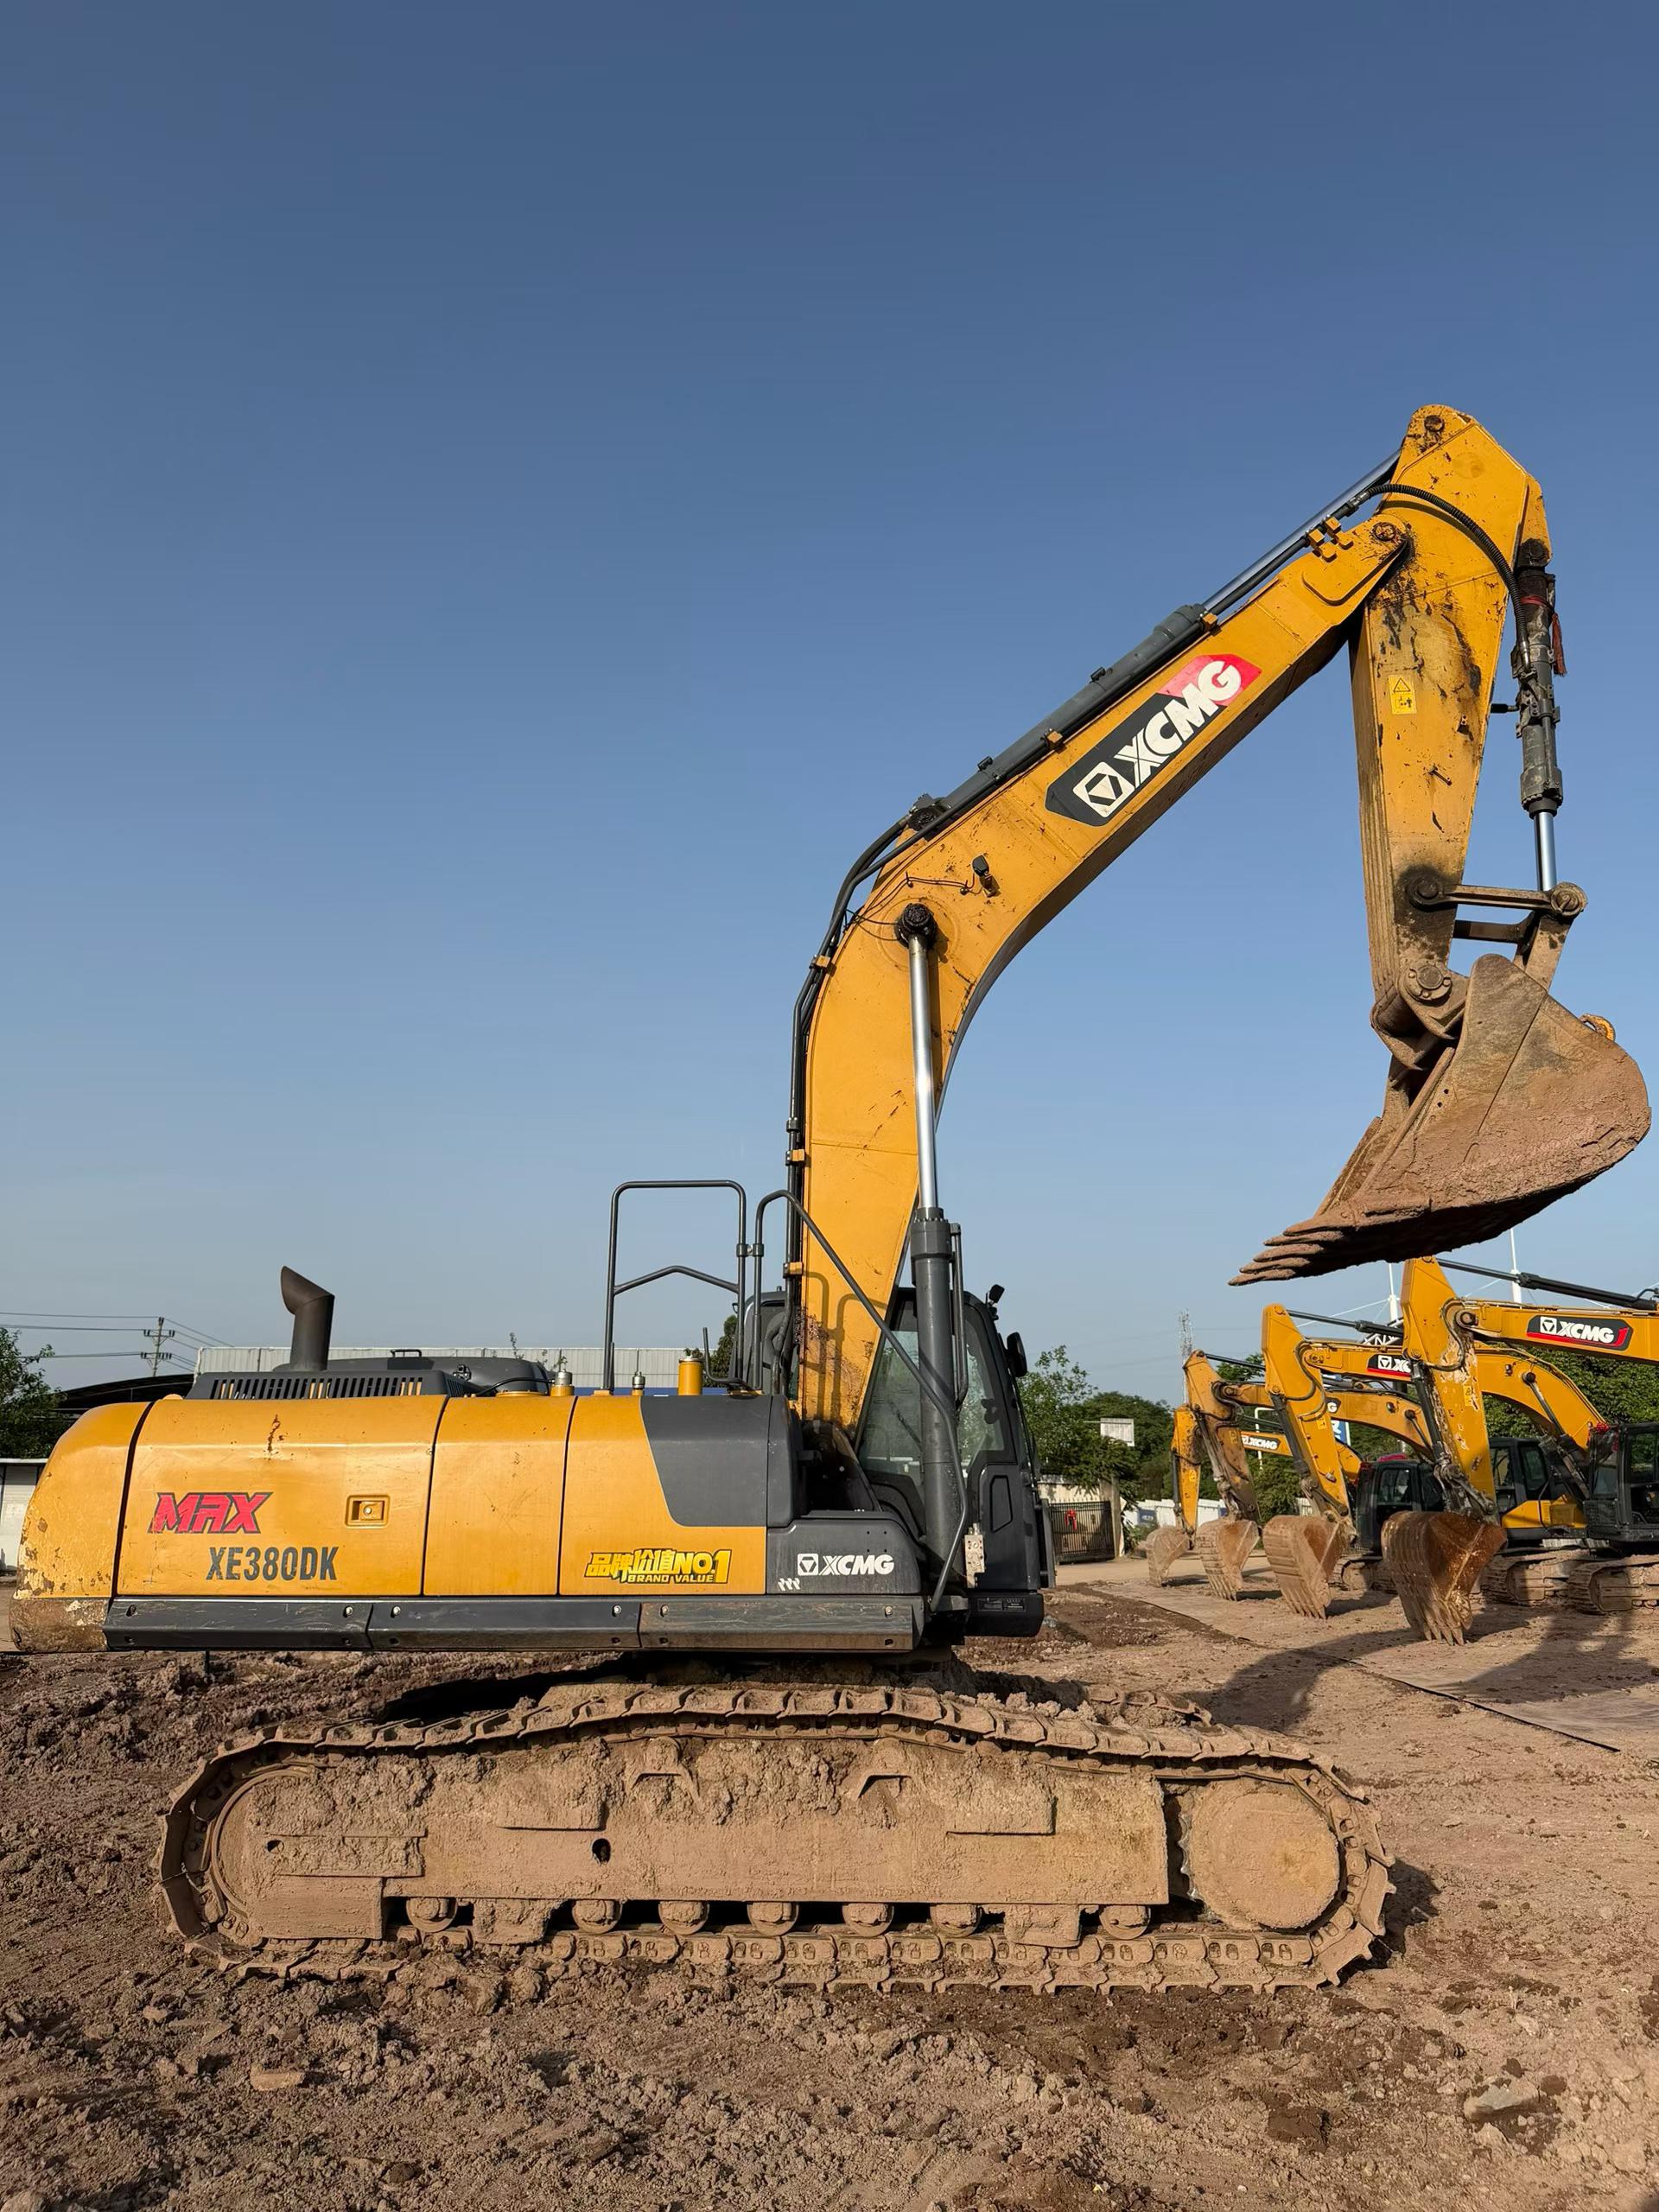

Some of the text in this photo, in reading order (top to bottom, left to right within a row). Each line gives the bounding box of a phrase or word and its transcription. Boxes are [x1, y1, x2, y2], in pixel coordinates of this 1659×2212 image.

[1114, 661, 1242, 789] XCMG
[1557, 1321, 1614, 1344] XCMG
[148, 1492, 274, 1534] MAX
[206, 1547, 340, 1581] XE380DK
[818, 1554, 894, 1575] XCMG
[627, 1574, 714, 1583] BRAND VALUE
